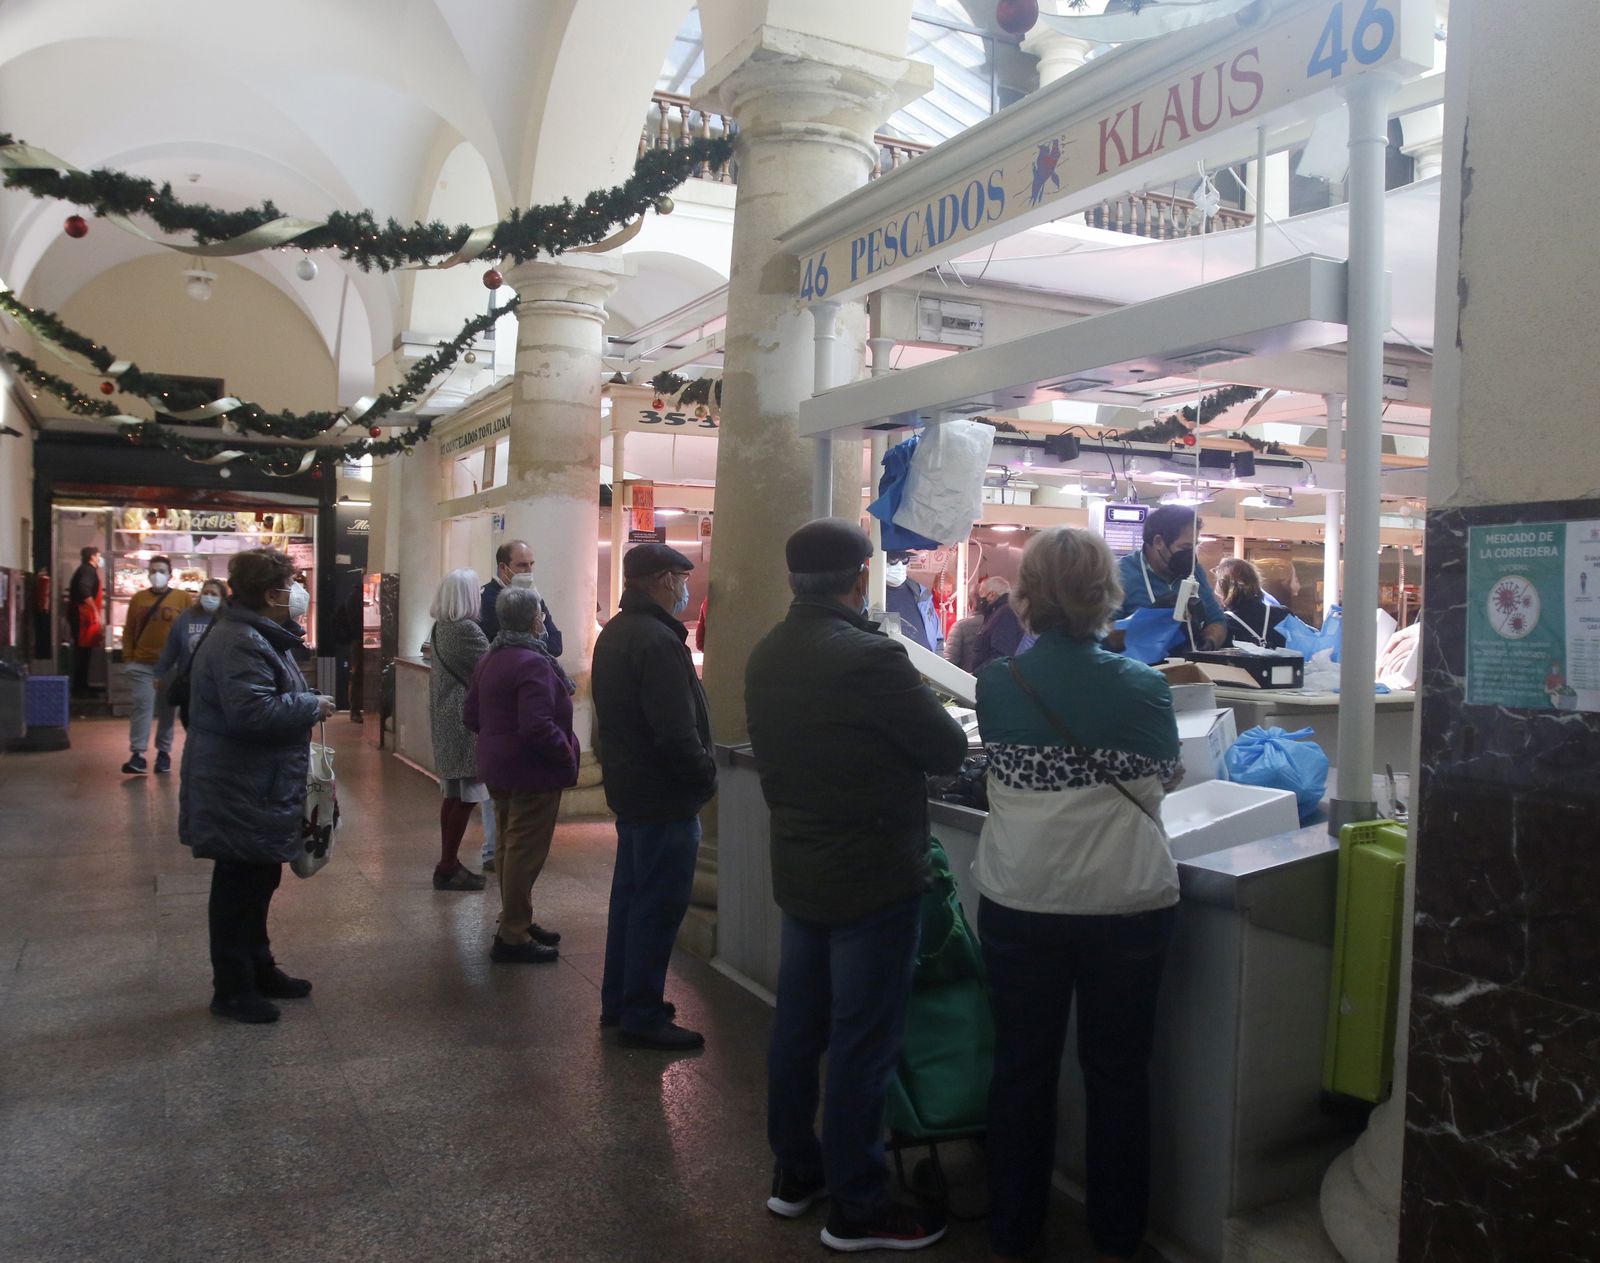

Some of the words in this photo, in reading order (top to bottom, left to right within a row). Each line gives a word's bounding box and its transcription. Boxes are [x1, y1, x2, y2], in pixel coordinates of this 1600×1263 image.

[801, 251, 829, 300] 46
[851, 168, 1006, 282] PESCADOS
[1096, 46, 1265, 176] KLAUS
[1306, 0, 1395, 79] 46
[1486, 532, 1536, 544] MERCADO
[1539, 531, 1554, 542] DE
[1480, 549, 1492, 559] LA
[1494, 546, 1559, 559] CORREDERA
